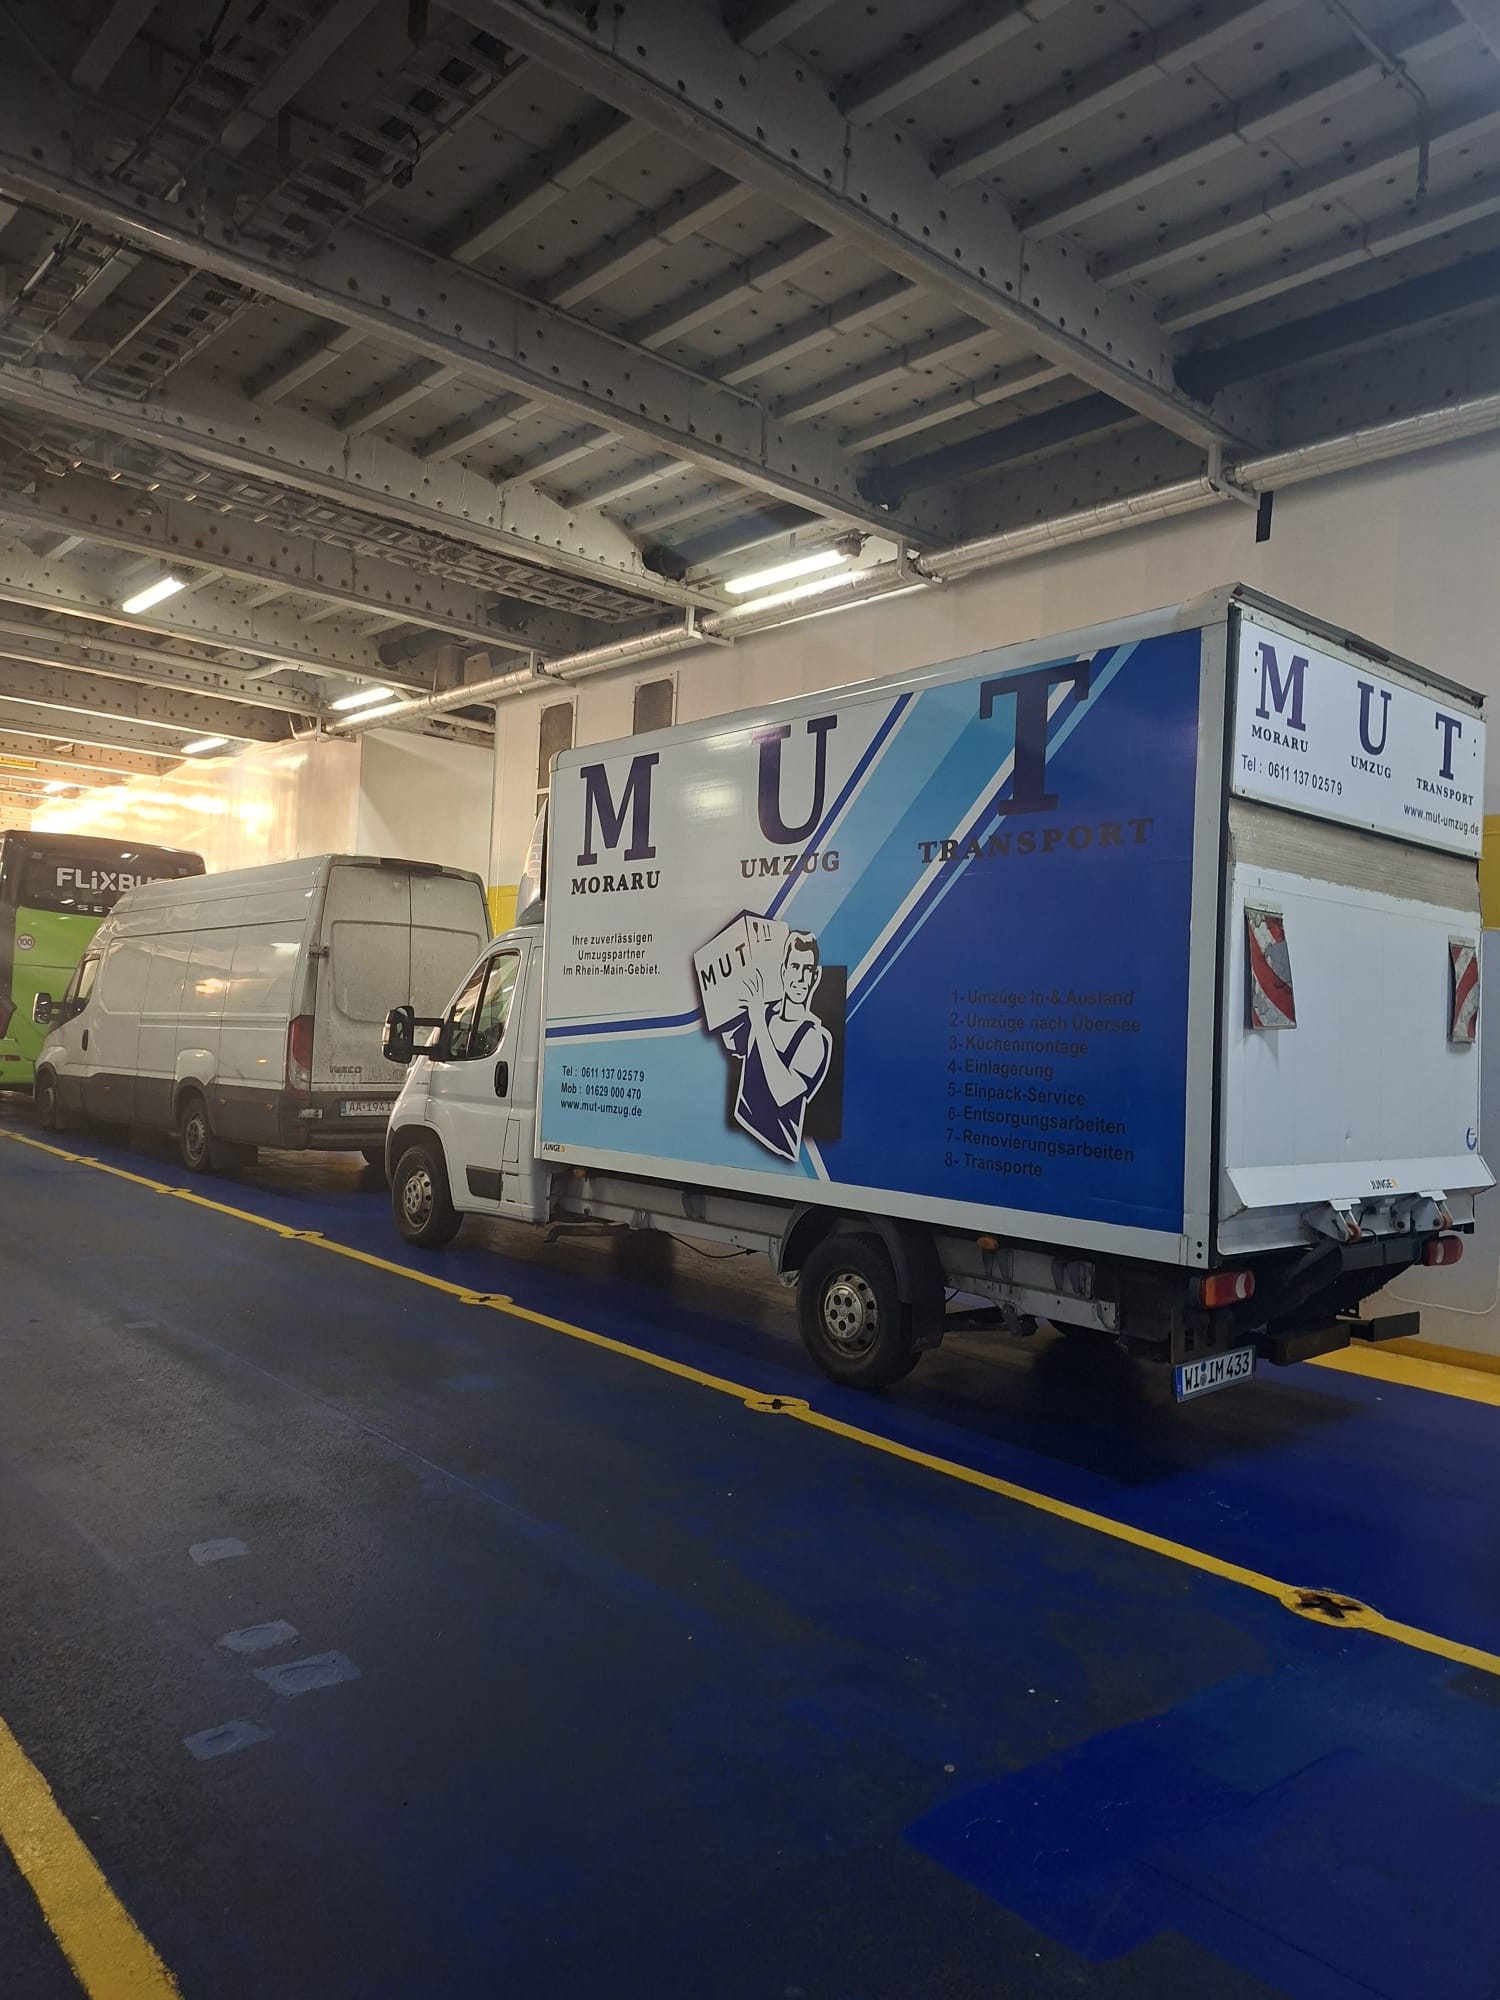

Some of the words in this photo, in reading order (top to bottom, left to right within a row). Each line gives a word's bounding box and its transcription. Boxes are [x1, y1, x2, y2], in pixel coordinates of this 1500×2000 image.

[1255, 641, 1309, 732] M
[1357, 680, 1392, 756] U
[1435, 712, 1462, 781] T
[1252, 724, 1309, 752] MORARU
[577, 752, 660, 866] M
[751, 714, 838, 845] U
[979, 659, 1090, 816] T
[1351, 755, 1392, 779] UMZUG
[1268, 761, 1289, 781] 0611
[1294, 769, 1309, 786] 137
[1312, 774, 1342, 796] 02579
[1416, 777, 1474, 806] TRANSPORT
[1403, 804, 1480, 836] www.mut-umzug.de
[917, 817, 1155, 864] TRANSPORT
[740, 850, 840, 879] UMZUG
[570, 870, 661, 895] MORARU
[572, 935, 588, 946] Ihre
[591, 932, 653, 946] zuverlässigen
[578, 948, 645, 962] Umzugspartner
[700, 942, 746, 991] MUT
[563, 964, 573, 975] Im
[575, 963, 661, 976] Rhein-Main-Gebiet.
[967, 988, 1025, 1008] Umzüge
[1065, 988, 1134, 1007] Ausland
[967, 1012, 1025, 1032] Umzüge
[1029, 1016, 1066, 1032] nach
[966, 1035, 1088, 1058] Küchenmontage
[582, 1067, 598, 1078] 0611
[601, 1068, 615, 1079] 137
[617, 1069, 645, 1082] 02579
[965, 1058, 1053, 1081] Einlagerung
[585, 1084, 609, 1096] 01629
[610, 1086, 624, 1098] 000
[626, 1088, 641, 1100] 470
[964, 1082, 1086, 1106] Einpack-Service
[560, 1100, 642, 1118] www.mut-umzug.de
[964, 1105, 1126, 1135] Entsorgungsarbeiten
[963, 1128, 1135, 1162] Renovierungsarbeiten
[964, 1152, 1042, 1176] Transporte
[1185, 1365, 1200, 1391] WI
[1208, 1359, 1224, 1384] IM
[1226, 1352, 1250, 1378] 433
